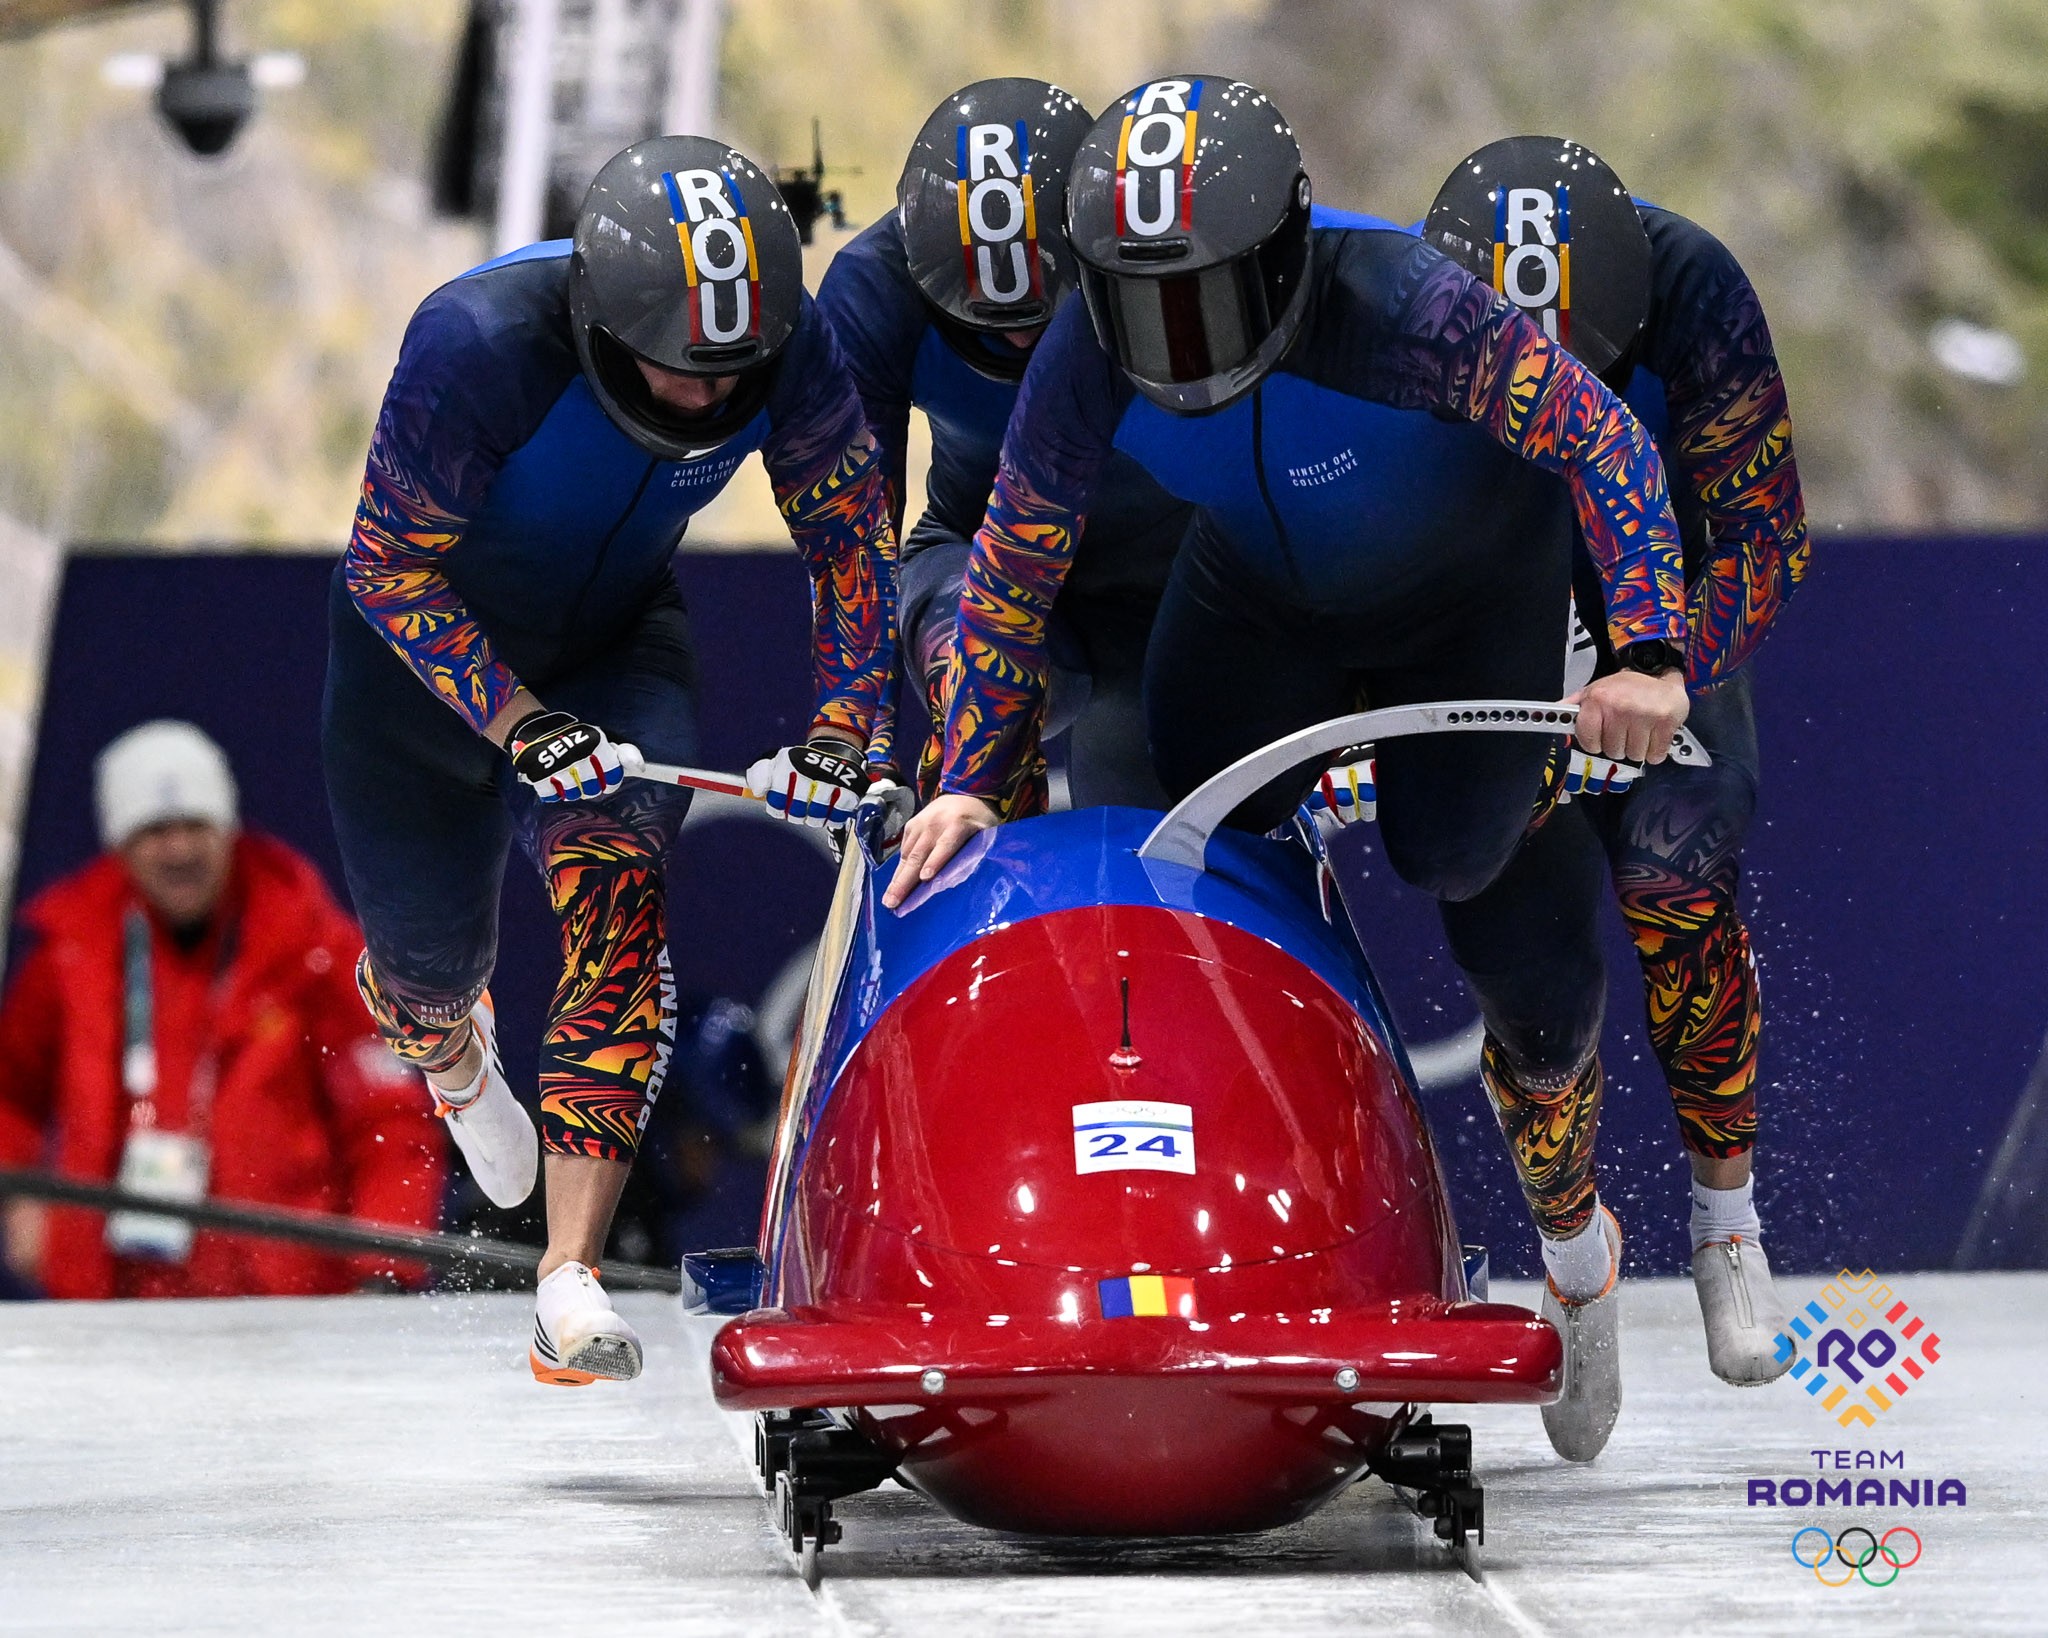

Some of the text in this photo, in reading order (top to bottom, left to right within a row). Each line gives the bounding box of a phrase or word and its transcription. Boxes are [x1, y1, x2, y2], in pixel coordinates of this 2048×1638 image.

[1125, 80, 1192, 237] ROU
[675, 168, 750, 343] ROU
[969, 123, 1030, 303] ROU
[1503, 188, 1560, 343] RO
[674, 464, 713, 478] NINETY
[1288, 448, 1353, 477] NINETY ONE
[1292, 458, 1358, 487] COLLECTIVE
[1089, 1133, 1181, 1157] 24
